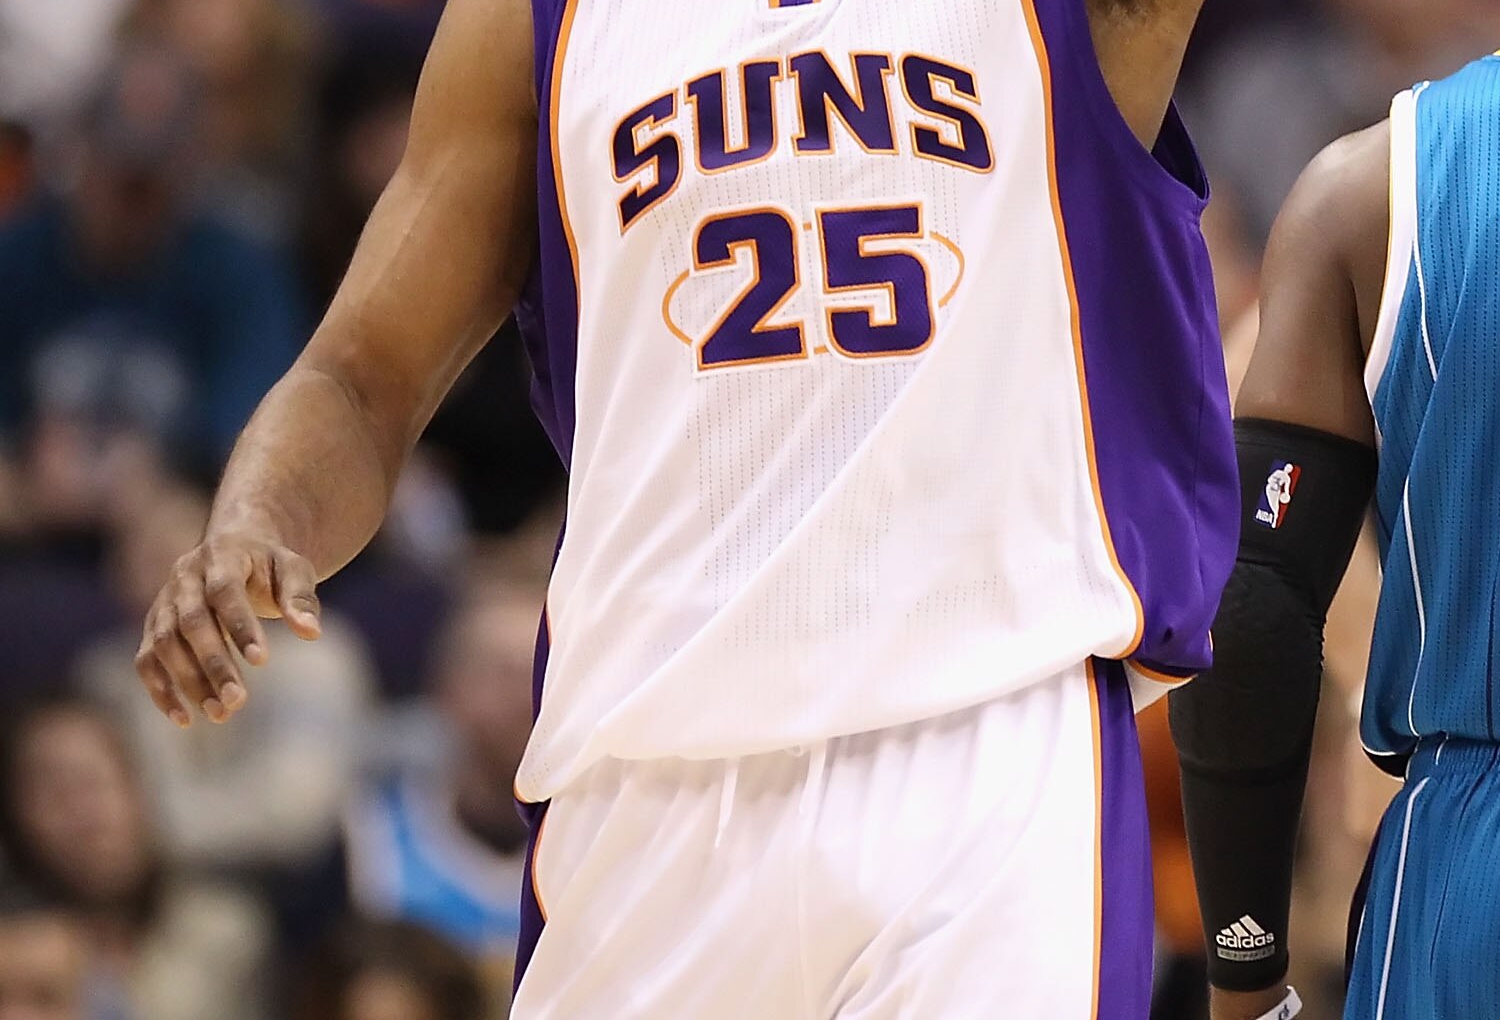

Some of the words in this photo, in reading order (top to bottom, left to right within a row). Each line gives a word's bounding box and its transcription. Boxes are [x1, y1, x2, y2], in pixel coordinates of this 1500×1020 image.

[611, 49, 995, 235] SUNS
[693, 201, 936, 371] 25
[1216, 932, 1274, 948] adidas
